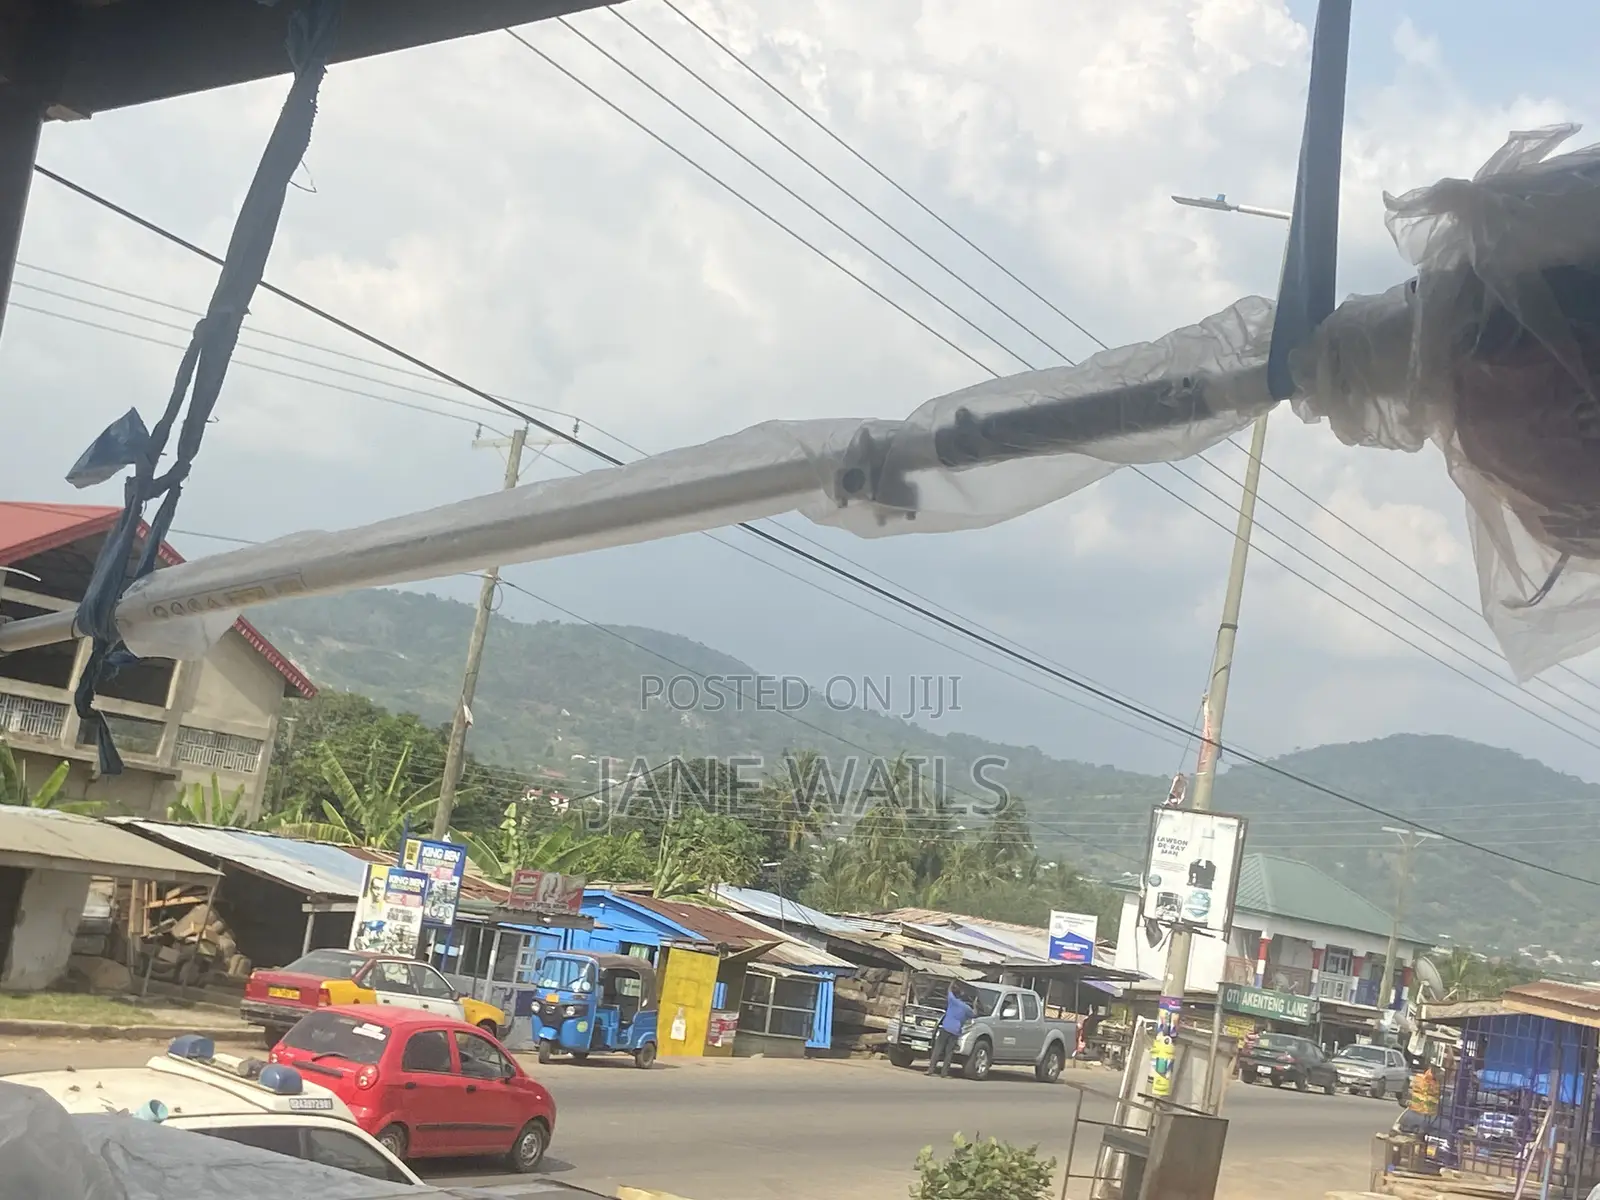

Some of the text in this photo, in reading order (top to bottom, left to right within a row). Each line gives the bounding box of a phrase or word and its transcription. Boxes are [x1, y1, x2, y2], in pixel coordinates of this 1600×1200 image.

[1156, 835, 1188, 847] LAWSON
[421, 845, 444, 860] KING
[443, 849, 461, 863] BEN
[388, 874, 409, 886] KING
[408, 876, 426, 888] BEN
[1241, 991, 1285, 1013] AKENTENG
[1286, 1000, 1309, 1018] LANE
